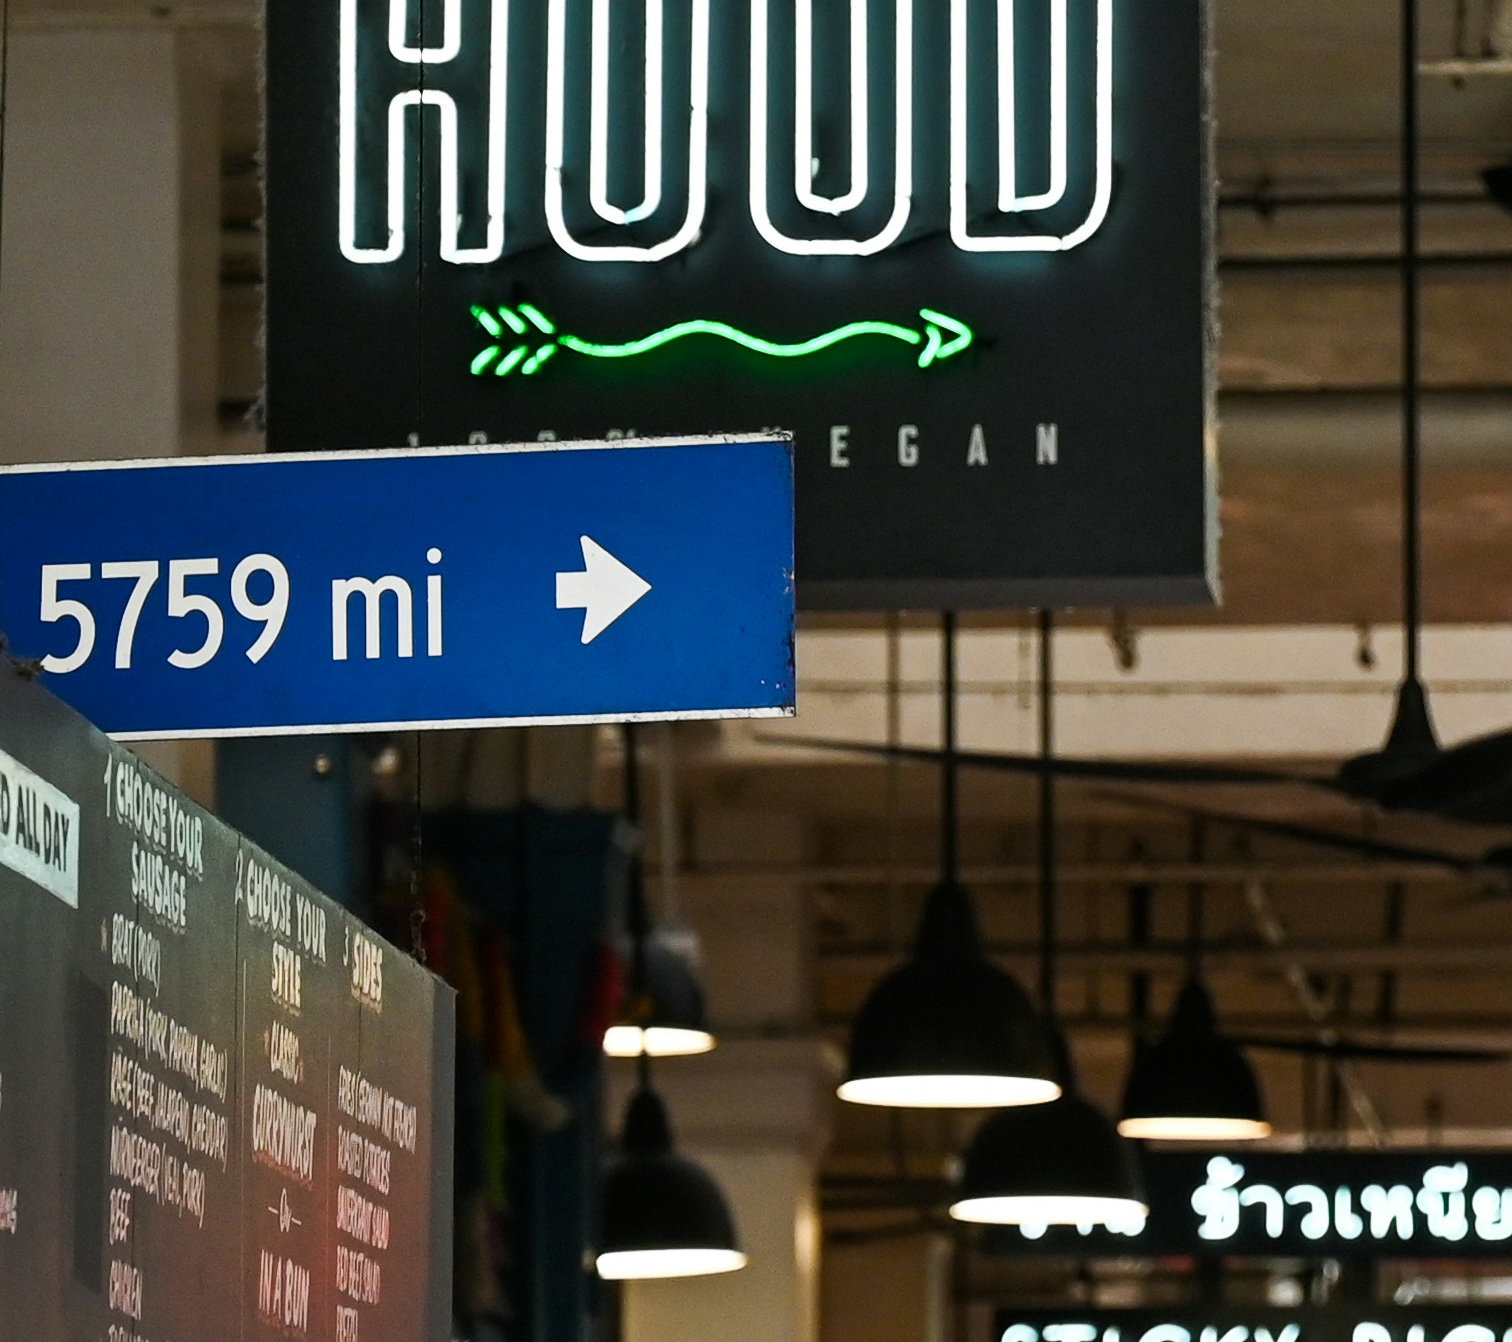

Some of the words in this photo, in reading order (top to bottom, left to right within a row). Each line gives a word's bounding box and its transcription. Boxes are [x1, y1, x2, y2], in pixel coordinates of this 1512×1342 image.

[762, 423, 1060, 467] EGAN
[39, 552, 290, 674] 5759
[331, 547, 444, 660] mi
[15, 785, 40, 856] ALL
[43, 803, 69, 871] DAY
[103, 753, 112, 816] 1
[116, 761, 166, 845] CHOOSE
[168, 796, 202, 873] YOUR
[131, 841, 185, 925] SAUSAGE
[234, 848, 243, 904] 2
[246, 859, 290, 935] CHOOSE
[296, 893, 325, 961] YOUR
[271, 941, 300, 1007] STYLE
[342, 926, 349, 966] 3
[352, 933, 382, 1001] SIDES
[252, 1083, 316, 1180] CURRYWURST
[259, 1250, 272, 1311] IN
[272, 1257, 281, 1315] A
[284, 1258, 309, 1329] BUN
